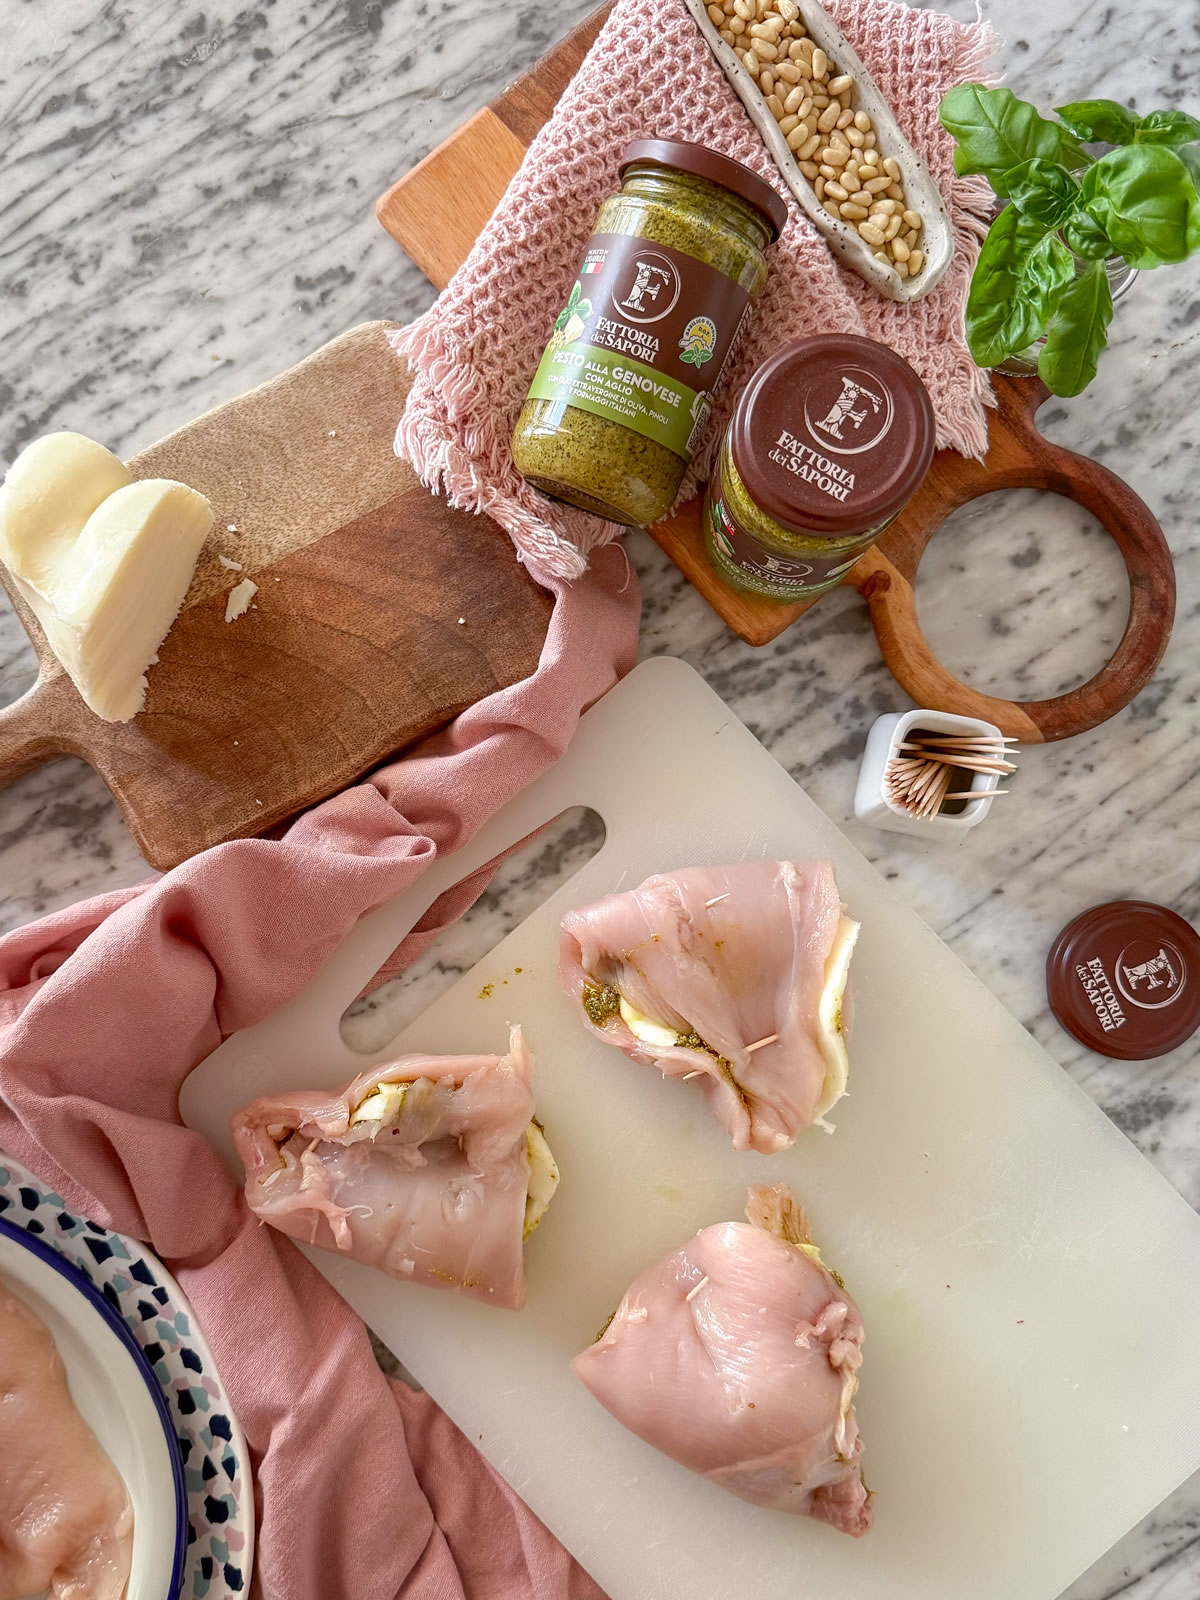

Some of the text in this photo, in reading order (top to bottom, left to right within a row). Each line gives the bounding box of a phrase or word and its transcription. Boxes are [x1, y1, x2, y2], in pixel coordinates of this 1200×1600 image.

[590, 331, 657, 363] dei SAPORI
[595, 316, 660, 351] FATTORIA
[552, 350, 682, 408] PESTO ALLA GENOVESE
[571, 380, 620, 402] EXTRAVERGINE
[619, 396, 628, 405] DI
[648, 409, 669, 425] PINOLI
[572, 388, 609, 406] FORMAGGI
[608, 401, 637, 418] ITALIANI
[585, 372, 633, 396] CON AGLIO
[768, 448, 851, 503] dei SAPORI
[775, 430, 856, 490] FATTORIA
[1075, 964, 1116, 1033] dei SAPORI
[1086, 956, 1127, 1029] FATTORIA
